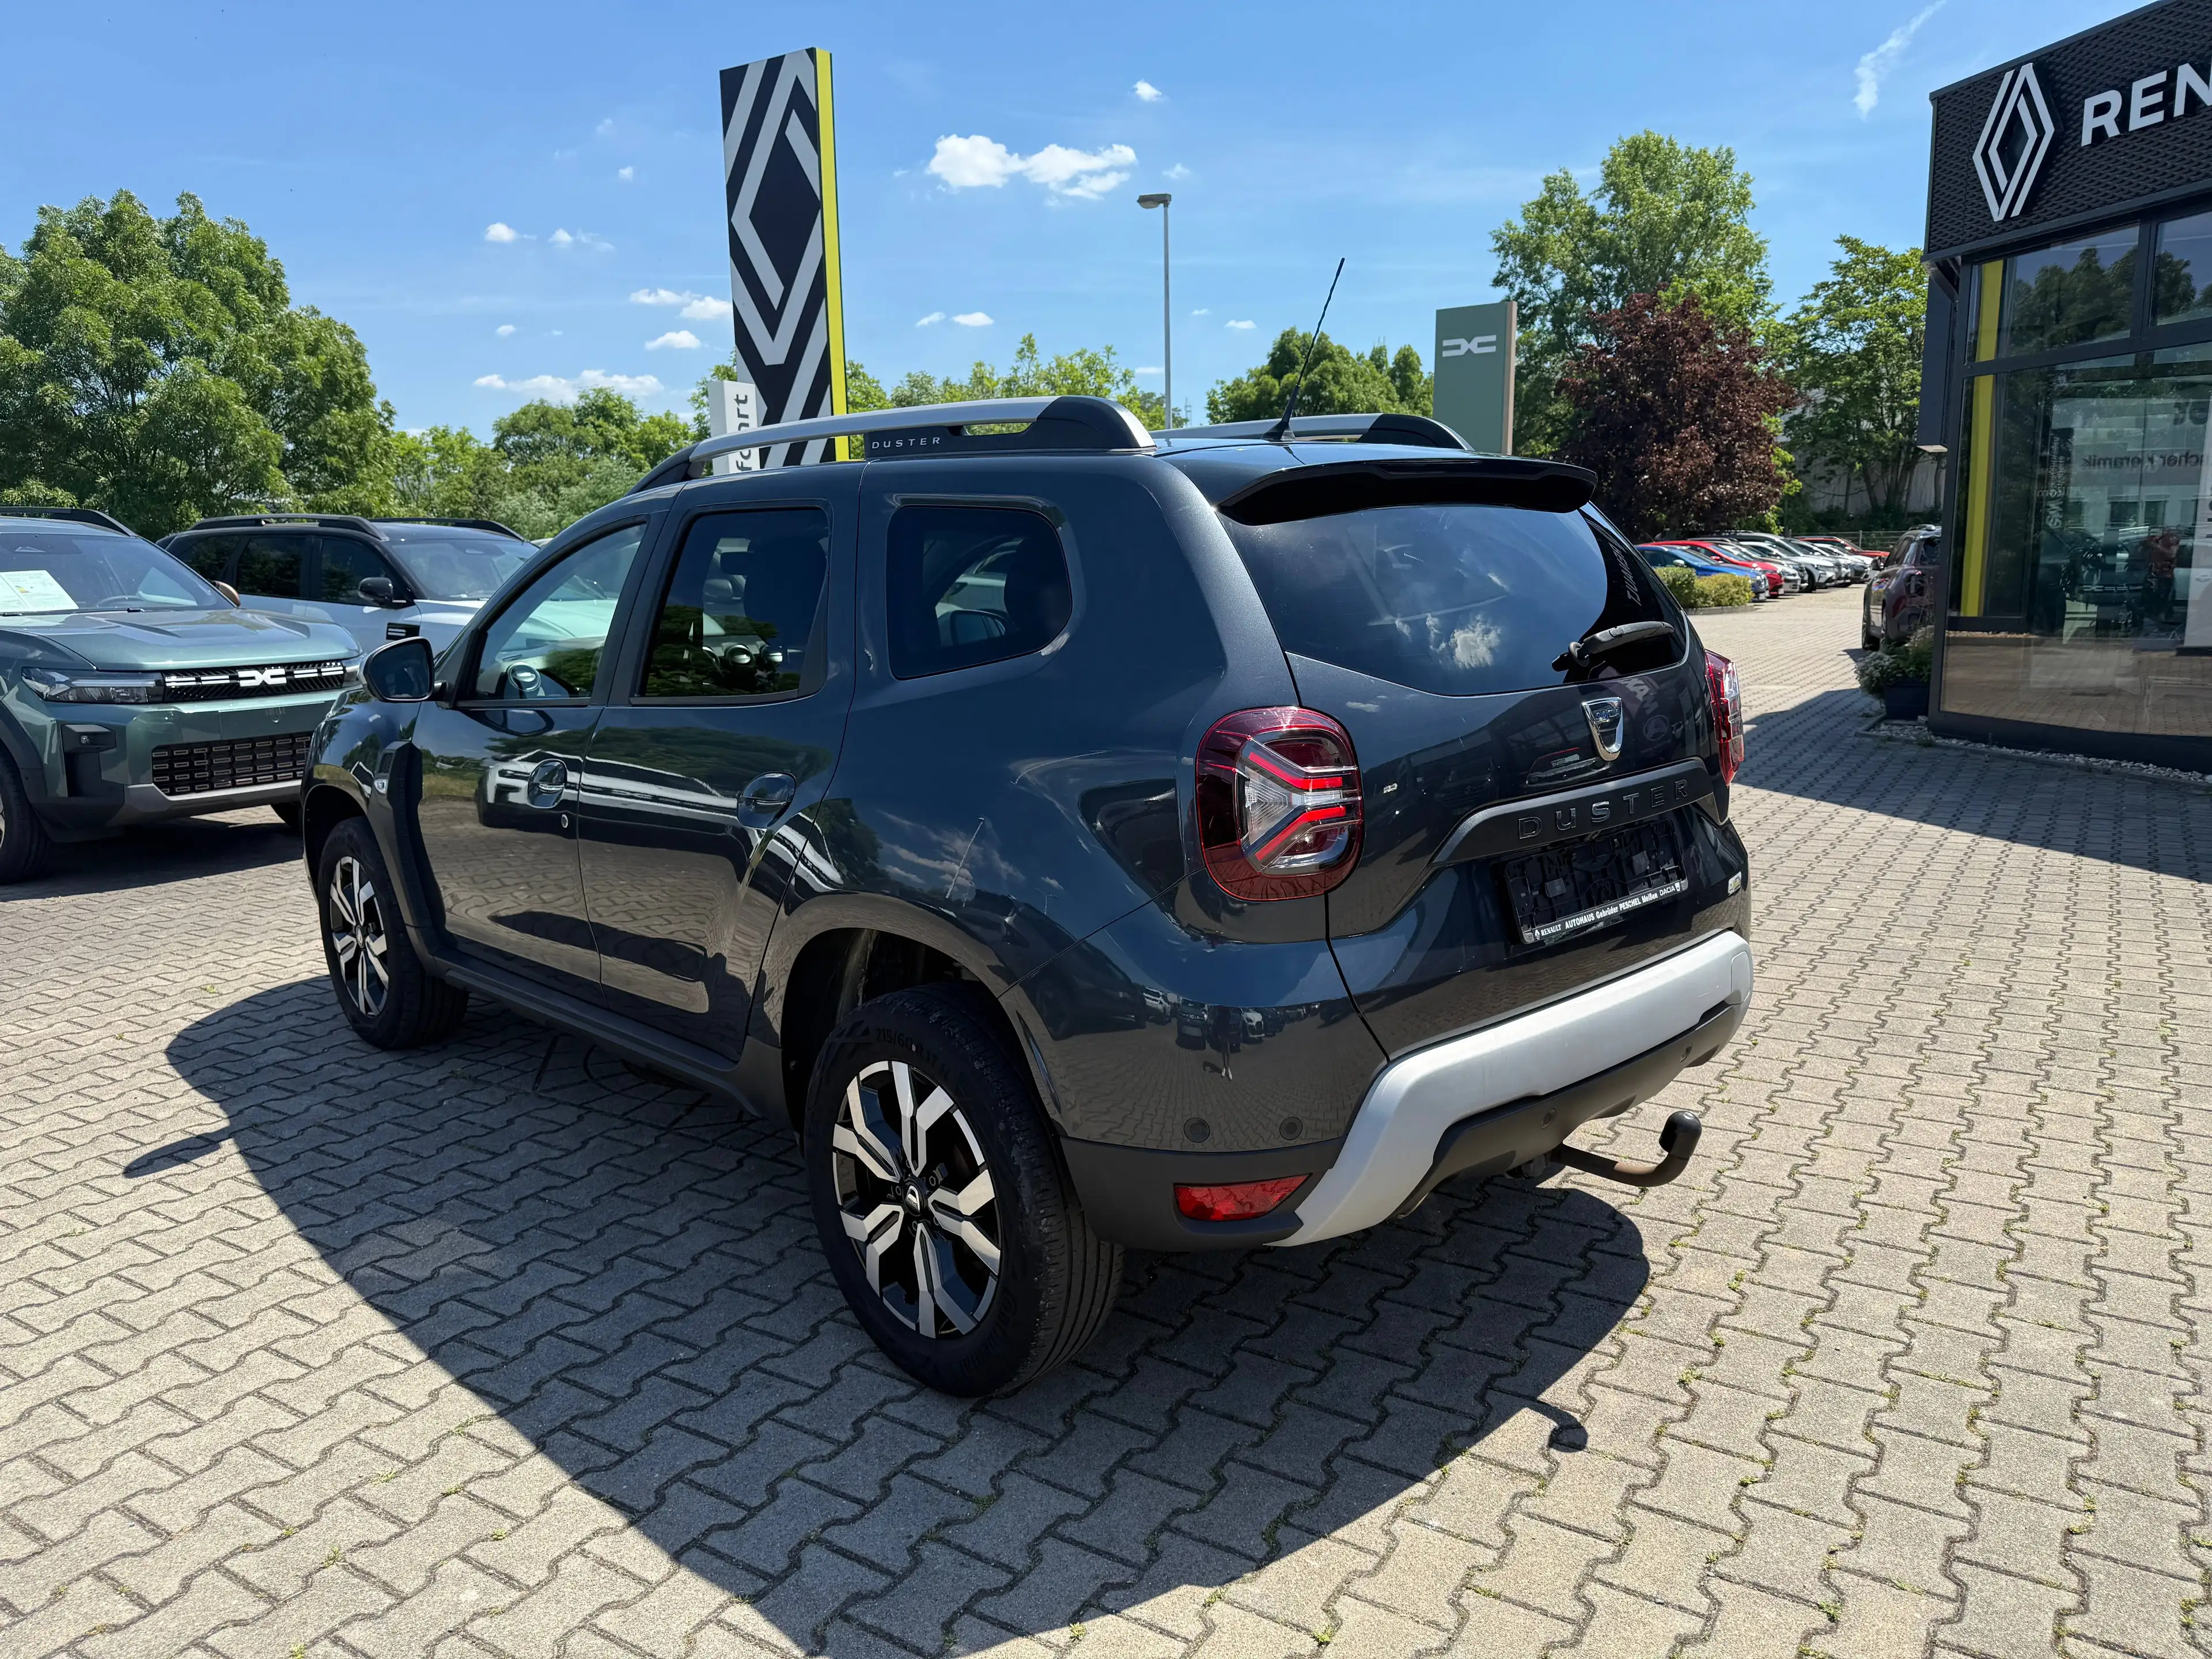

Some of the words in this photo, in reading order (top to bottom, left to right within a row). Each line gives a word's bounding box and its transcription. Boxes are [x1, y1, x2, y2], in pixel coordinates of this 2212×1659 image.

[872, 437, 940, 449] DUSTER
[1518, 779, 1688, 839] DUSTER
[1540, 923, 1561, 936] RENAULT
[1565, 912, 1595, 930] AUTOHAUS
[1596, 906, 1618, 919] Gebrüder
[1619, 897, 1641, 911] PESCHEL
[1641, 893, 1658, 903] Meißen
[1659, 885, 1676, 896] DACIA
